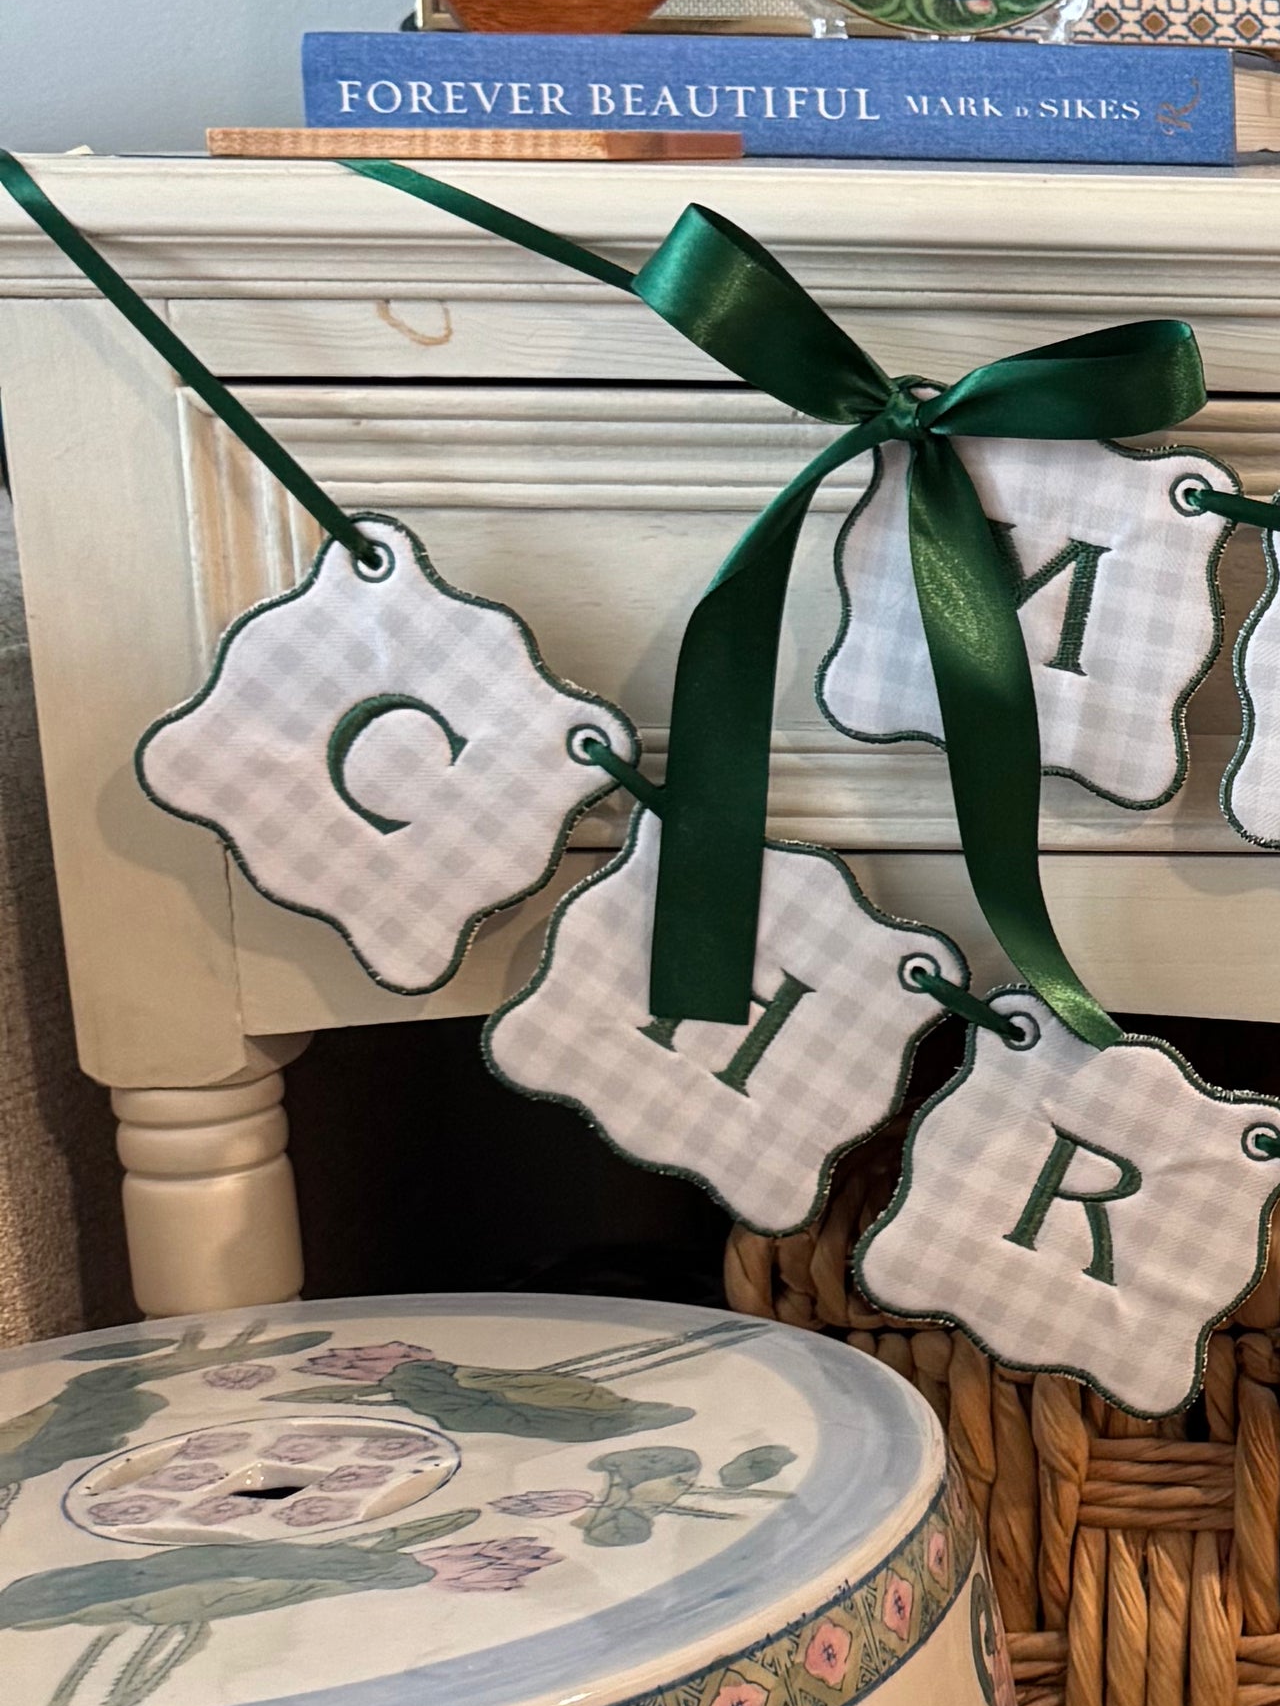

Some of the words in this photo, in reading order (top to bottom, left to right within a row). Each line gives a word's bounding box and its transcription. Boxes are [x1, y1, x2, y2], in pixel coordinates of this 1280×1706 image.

[337, 80, 572, 116] FOREVER
[589, 83, 881, 121] BEAUTIFUL
[905, 95, 1003, 117] MARK
[1039, 98, 1141, 120] SIKES
